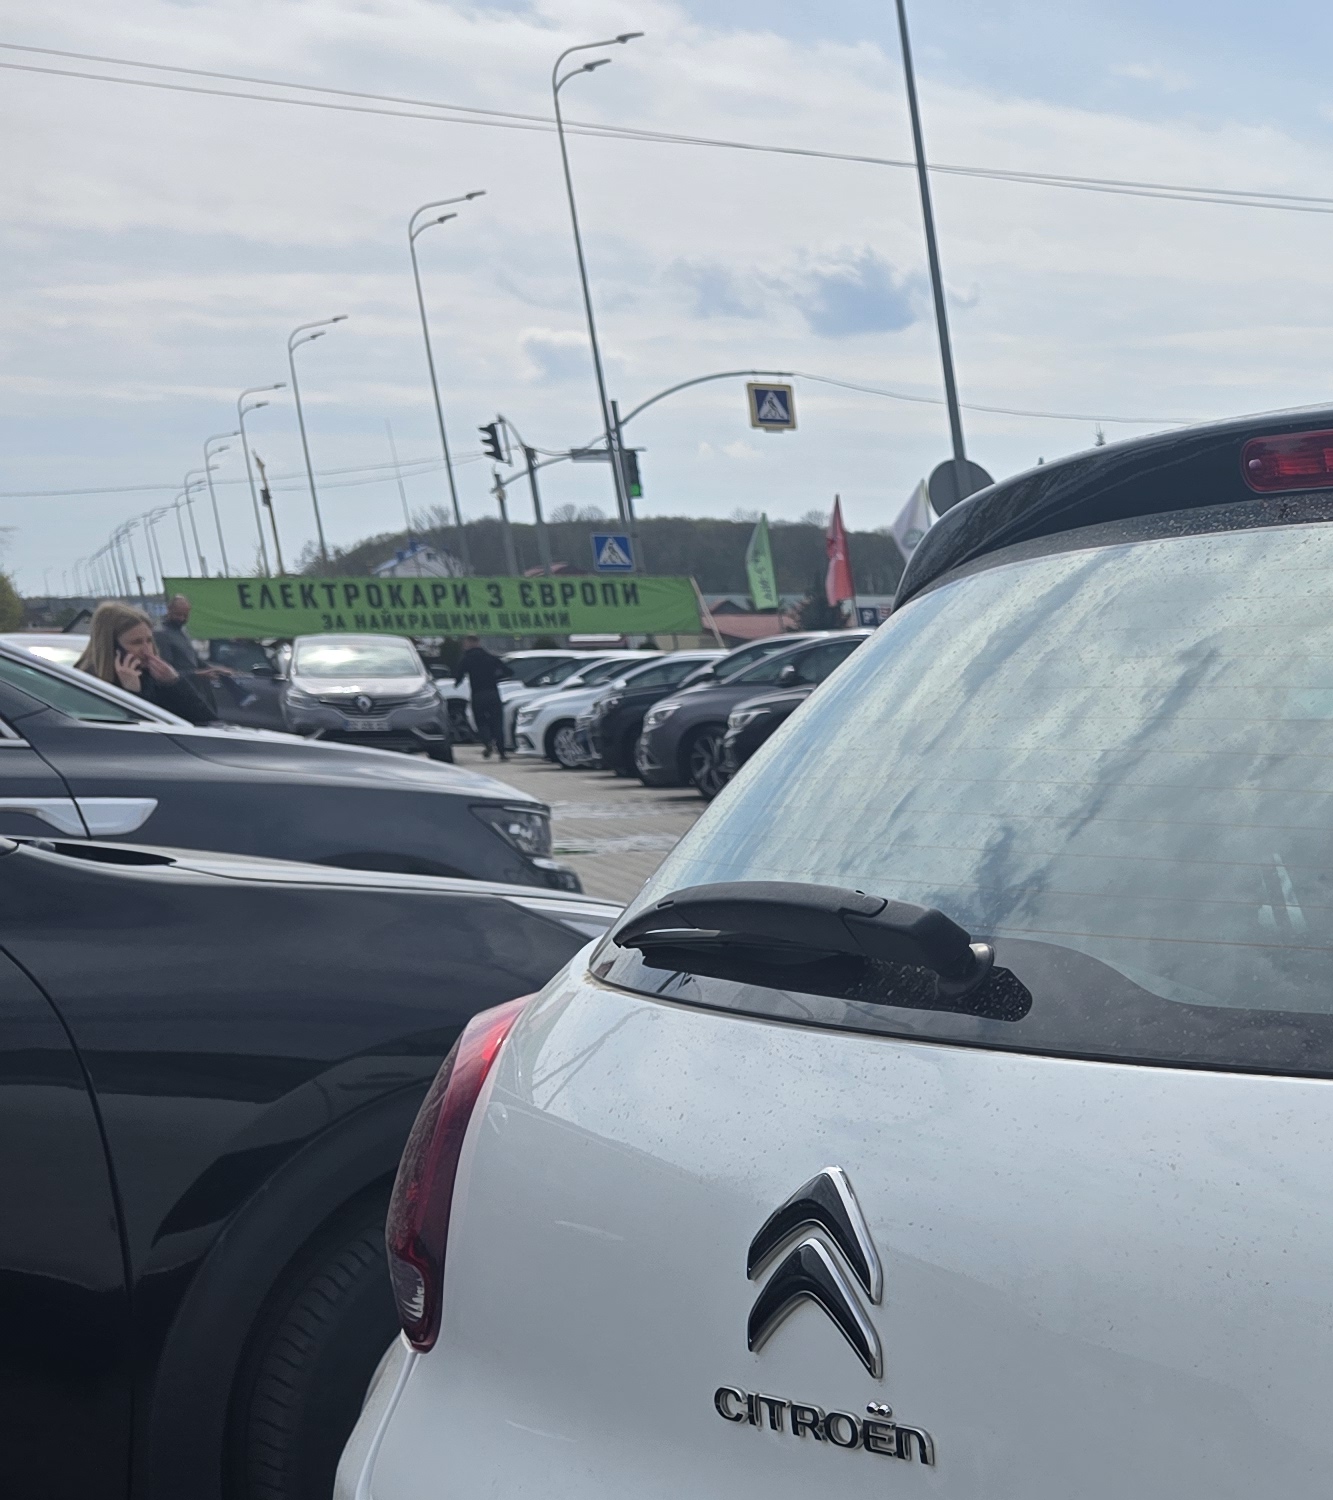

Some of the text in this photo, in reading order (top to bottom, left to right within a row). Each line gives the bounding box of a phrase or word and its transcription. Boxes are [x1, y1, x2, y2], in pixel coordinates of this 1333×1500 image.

[237, 583, 470, 610] ЕЛЕКТРОКАРИ
[519, 581, 640, 608] ЄВРОПИ
[321, 609, 572, 630] ЗА НАЙКРАЩИМИ ЦІНАМИ
